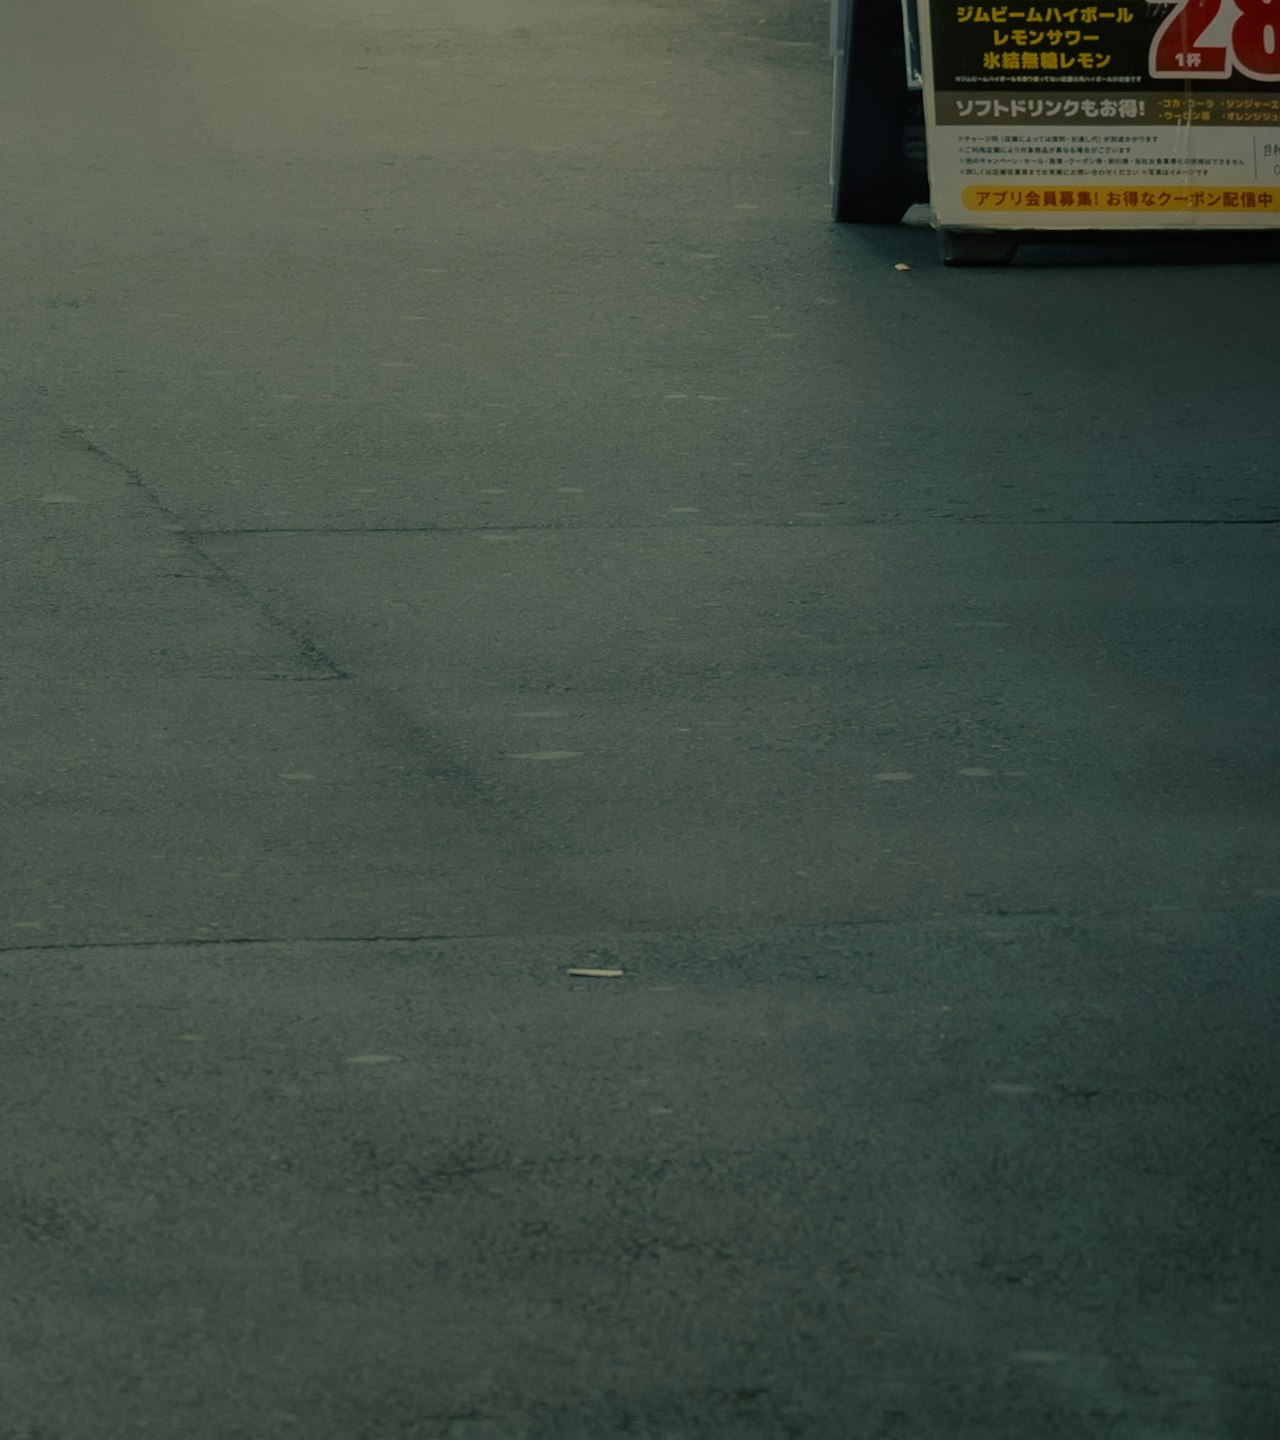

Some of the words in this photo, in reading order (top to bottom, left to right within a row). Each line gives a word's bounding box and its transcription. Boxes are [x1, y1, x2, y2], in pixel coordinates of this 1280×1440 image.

[956, 6, 1134, 24] ジムビームハイボール
[993, 30, 1100, 46] レモンサワー
[983, 52, 1112, 70] 氷結無糖レモン
[956, 98, 1146, 118] ソフトドリンクもお得!
[976, 190, 1100, 207] アプリ会員募集!
[1107, 190, 1274, 209] お得なクーポン配信中
